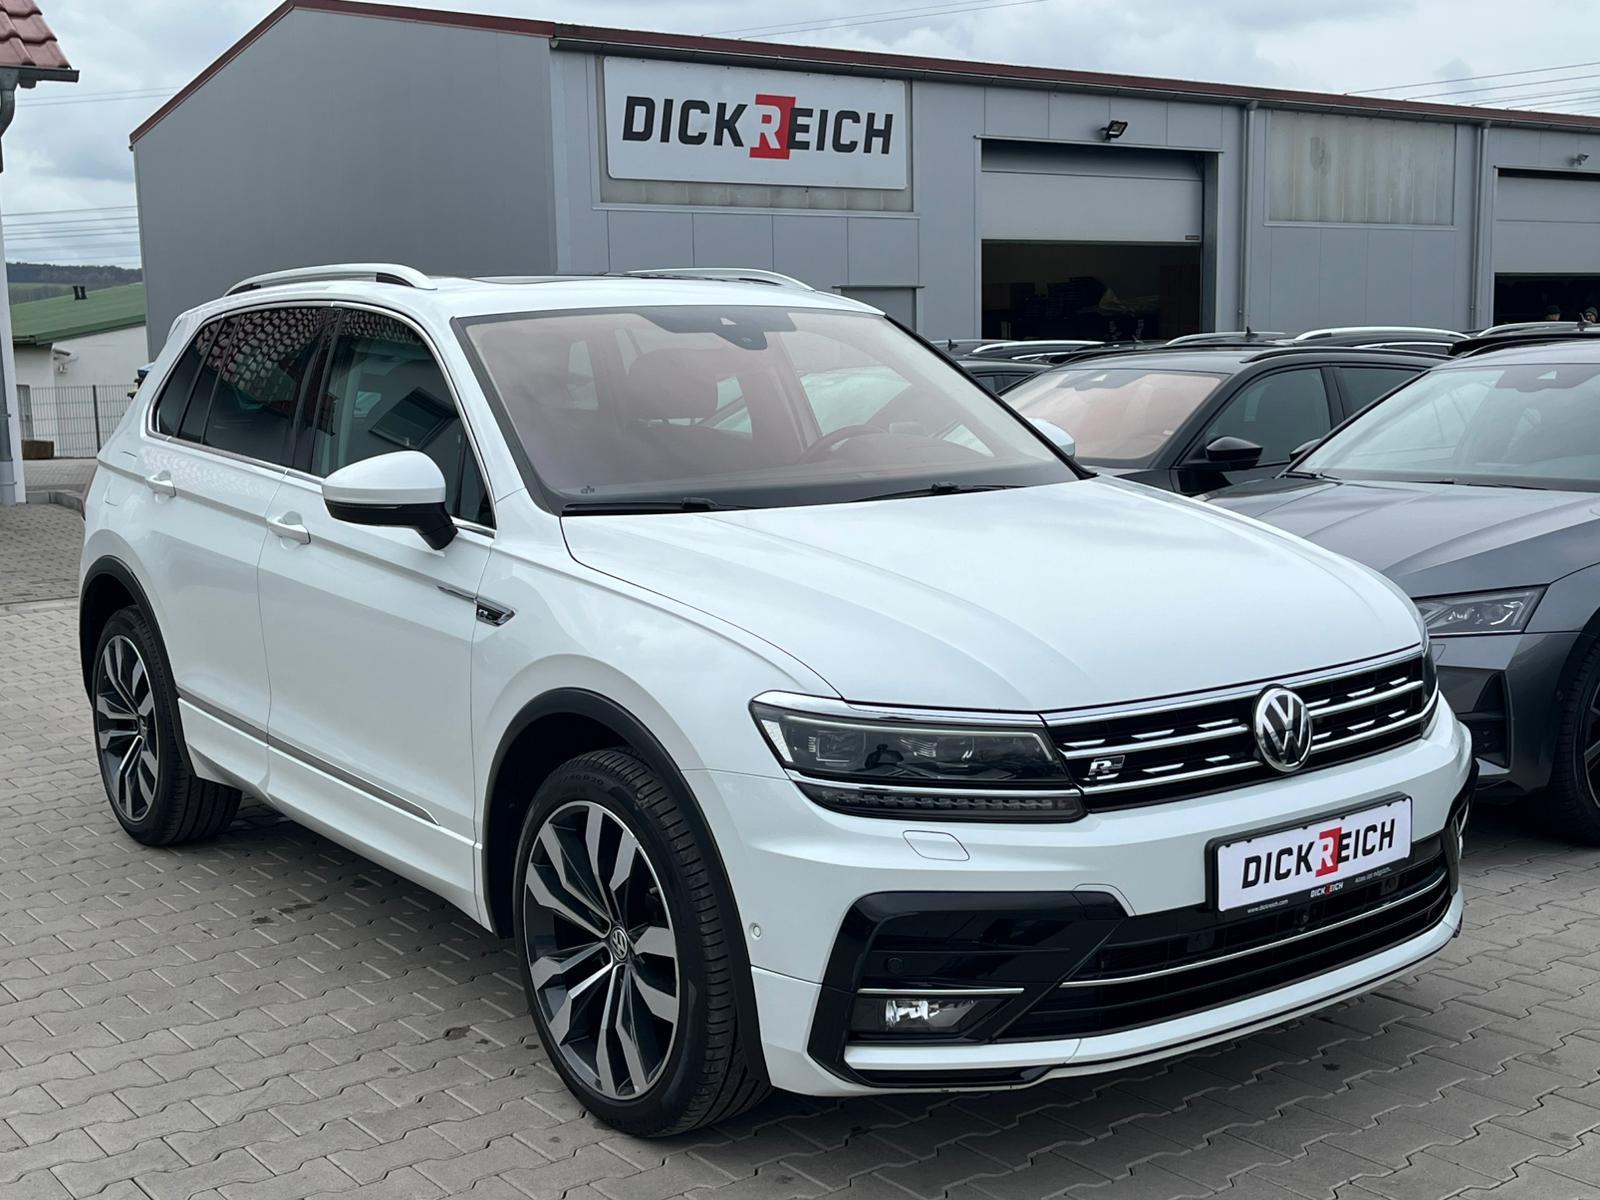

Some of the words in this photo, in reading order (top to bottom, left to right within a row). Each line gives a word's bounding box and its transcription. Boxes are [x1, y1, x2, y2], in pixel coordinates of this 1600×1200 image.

[622, 94, 894, 160] DICKREICH
[1255, 686, 1314, 772] VW
[1241, 818, 1396, 889] DICKREICH
[1310, 881, 1344, 898] DICKREICH
